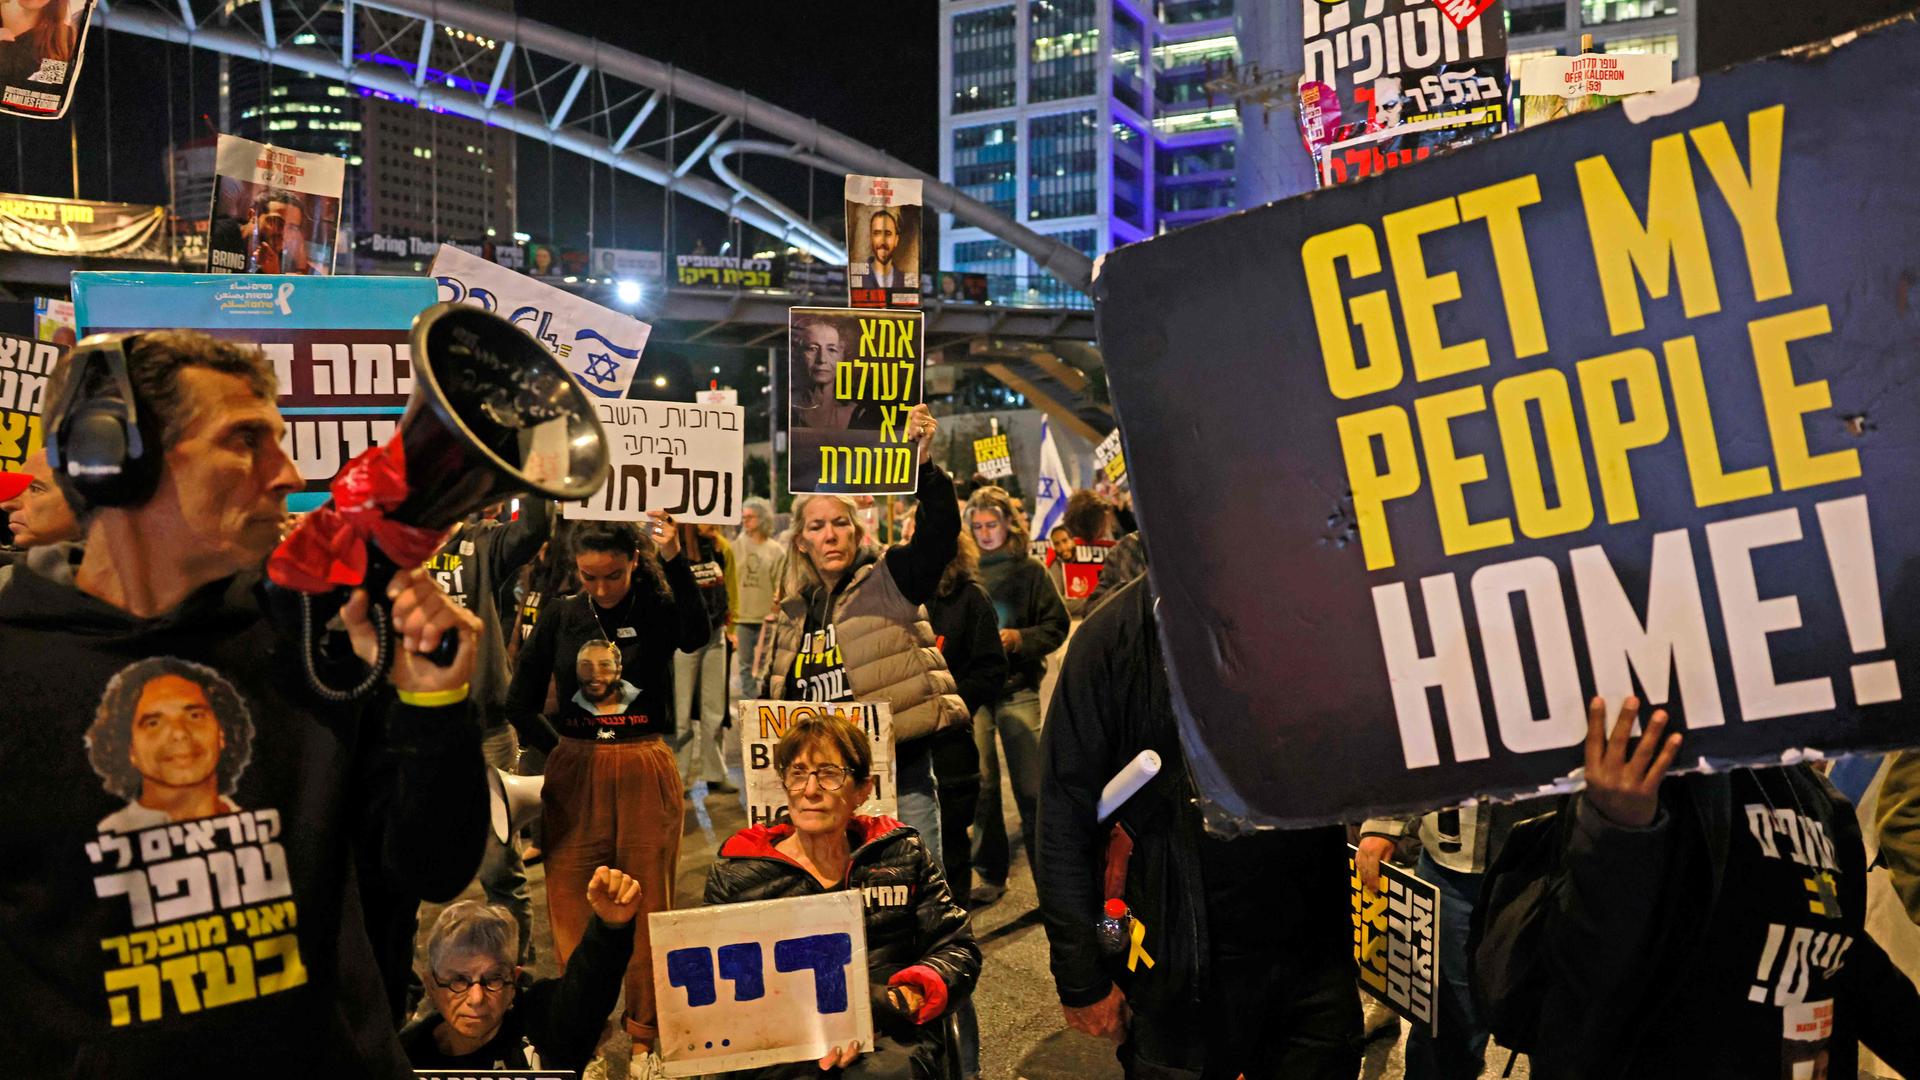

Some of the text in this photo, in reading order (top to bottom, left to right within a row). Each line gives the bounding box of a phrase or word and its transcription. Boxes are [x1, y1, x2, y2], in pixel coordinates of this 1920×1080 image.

[1565, 70, 1624, 83] OFER KALDERON
[212, 249, 246, 270] BRING
[373, 234, 406, 255] Bring
[1302, 104, 1792, 399] GET MY
[859, 319, 915, 358] אמא
[835, 359, 914, 401] לעולם
[600, 404, 739, 431] ברוכות השב
[880, 403, 913, 443] לא
[1337, 304, 1862, 571] PEOPLE
[623, 434, 687, 456] הביתה
[818, 446, 911, 484] מוותרת
[1371, 495, 1902, 769] HOME!
[85, 808, 281, 868] קוראים לי
[94, 842, 293, 927] עופר
[101, 901, 298, 966] ואני מופקר
[1387, 879, 1413, 1011] מעזה
[104, 933, 308, 1027] בעזה
